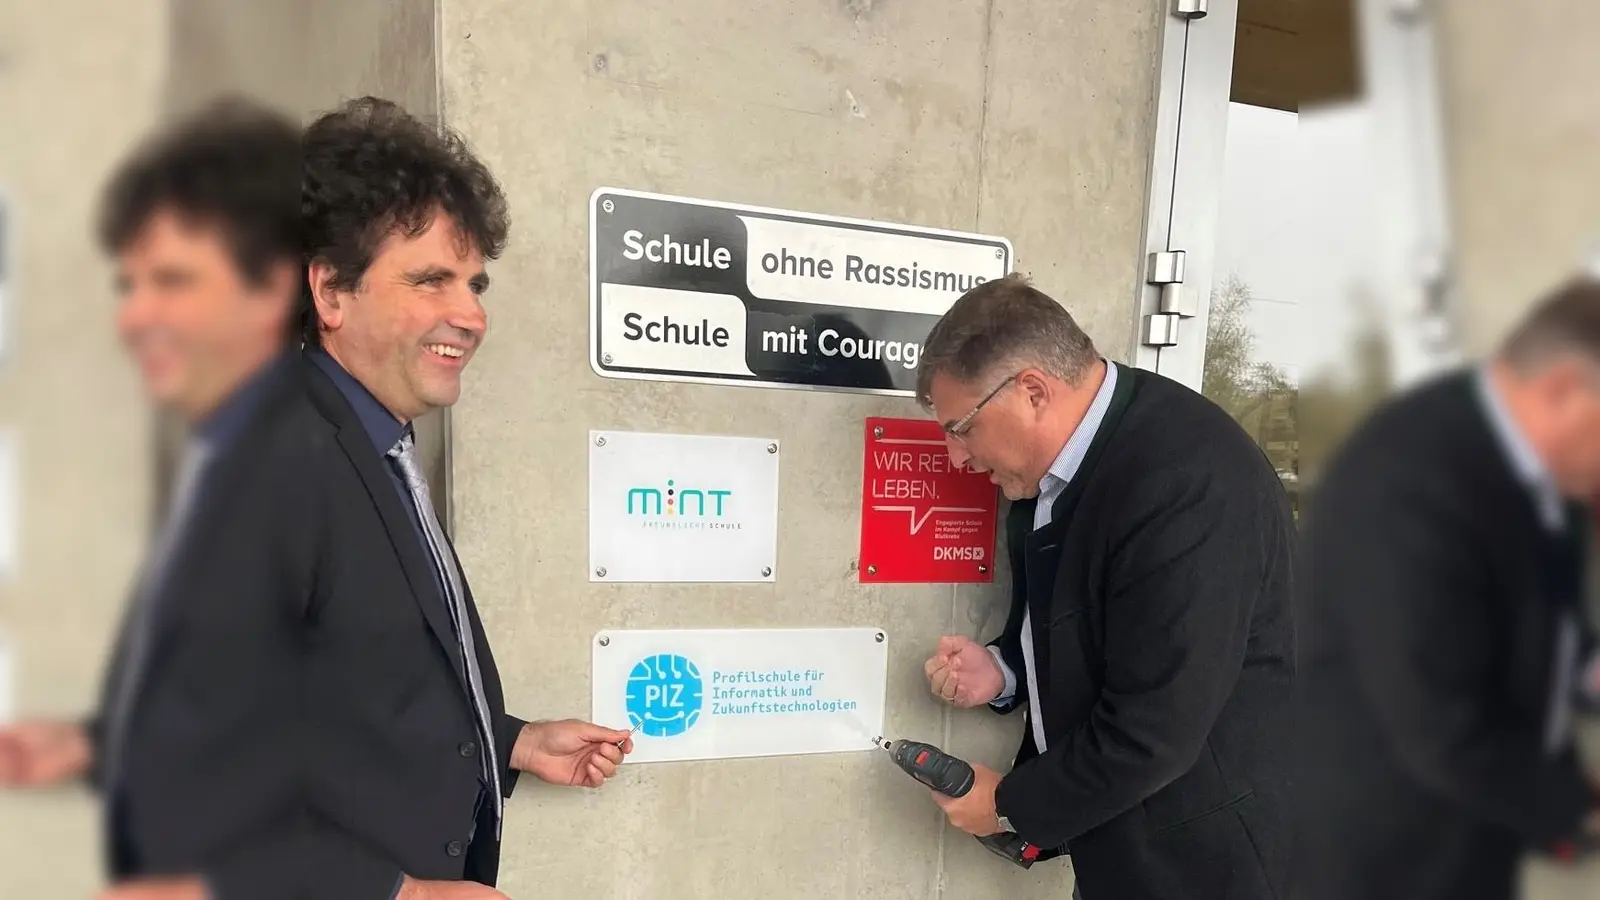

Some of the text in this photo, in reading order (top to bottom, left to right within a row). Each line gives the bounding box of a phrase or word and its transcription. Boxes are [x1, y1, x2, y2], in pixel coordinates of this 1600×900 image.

[622, 229, 732, 270] Schule
[761, 248, 834, 280] ohne
[623, 312, 924, 370] Schule mit Courag
[873, 451, 913, 472] WIR
[872, 478, 940, 499] LEBEN.
[709, 522, 742, 530] SCHULE
[713, 669, 825, 684] Profilschule für
[645, 684, 684, 709] PIZ
[712, 685, 812, 699] Informatik und
[712, 699, 857, 715] Zukunftstechnologien
